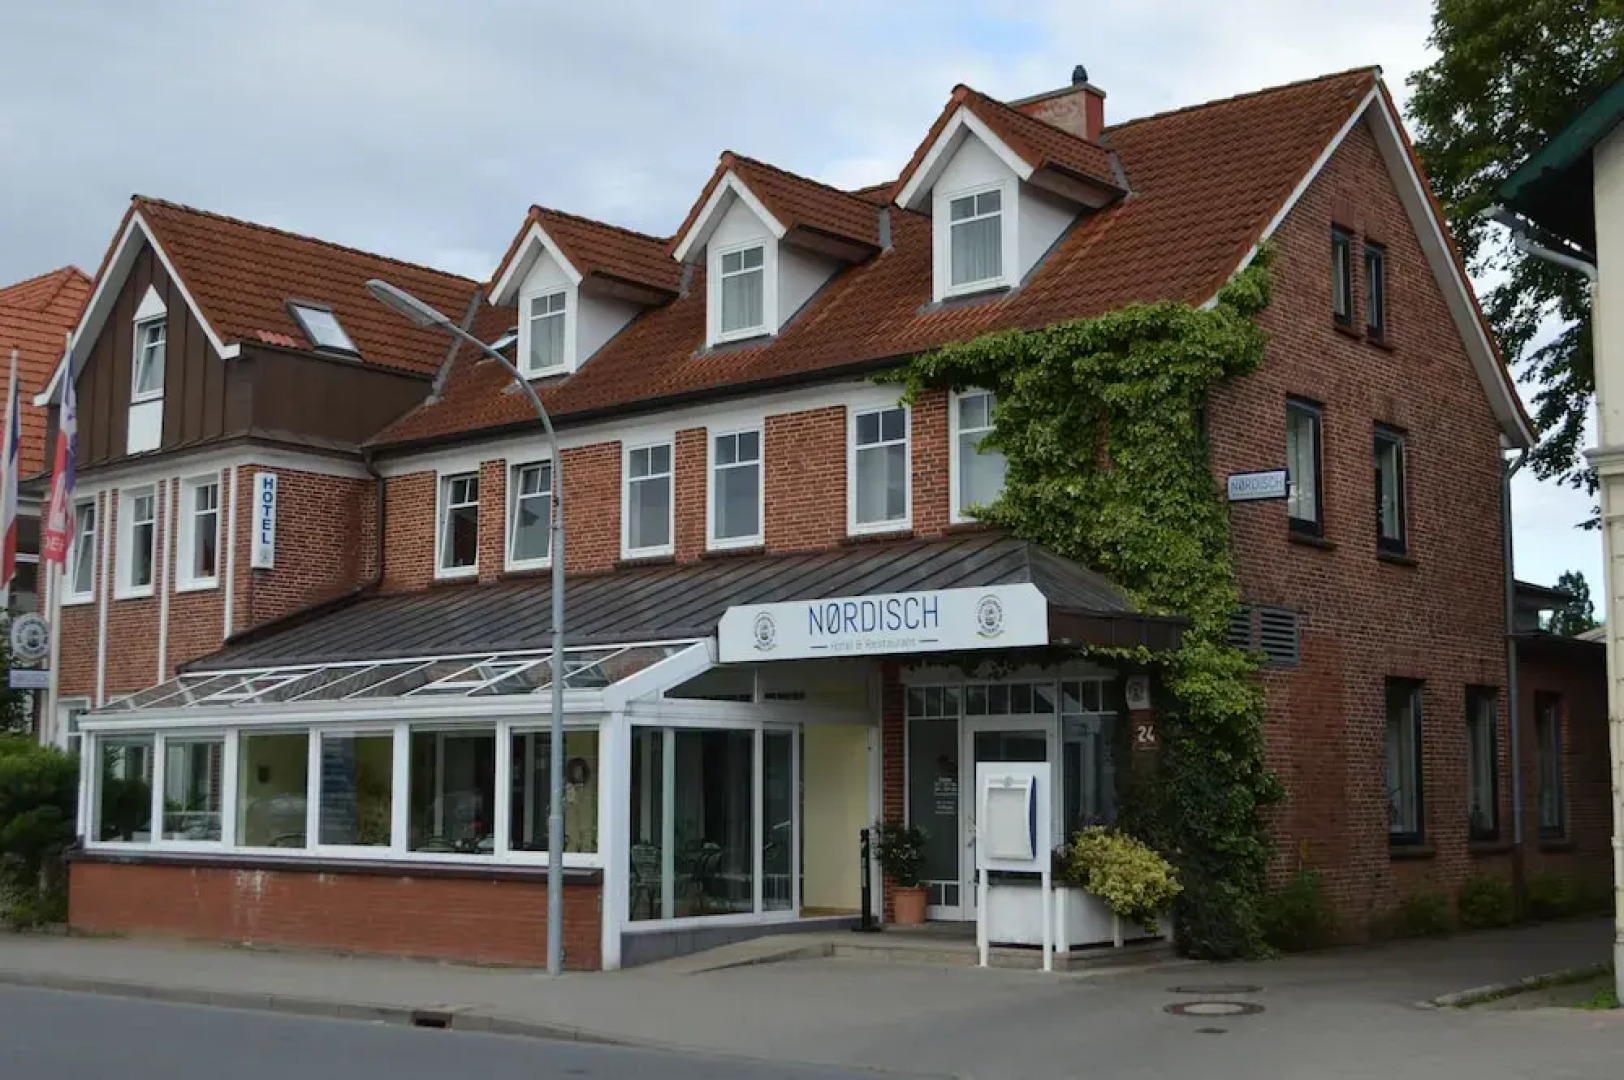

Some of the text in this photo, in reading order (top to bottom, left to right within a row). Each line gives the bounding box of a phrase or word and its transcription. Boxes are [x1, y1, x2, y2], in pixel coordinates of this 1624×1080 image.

[262, 477, 274, 545] HOTEL
[808, 596, 938, 635] NØRDISCH
[1137, 725, 1156, 743] 24
